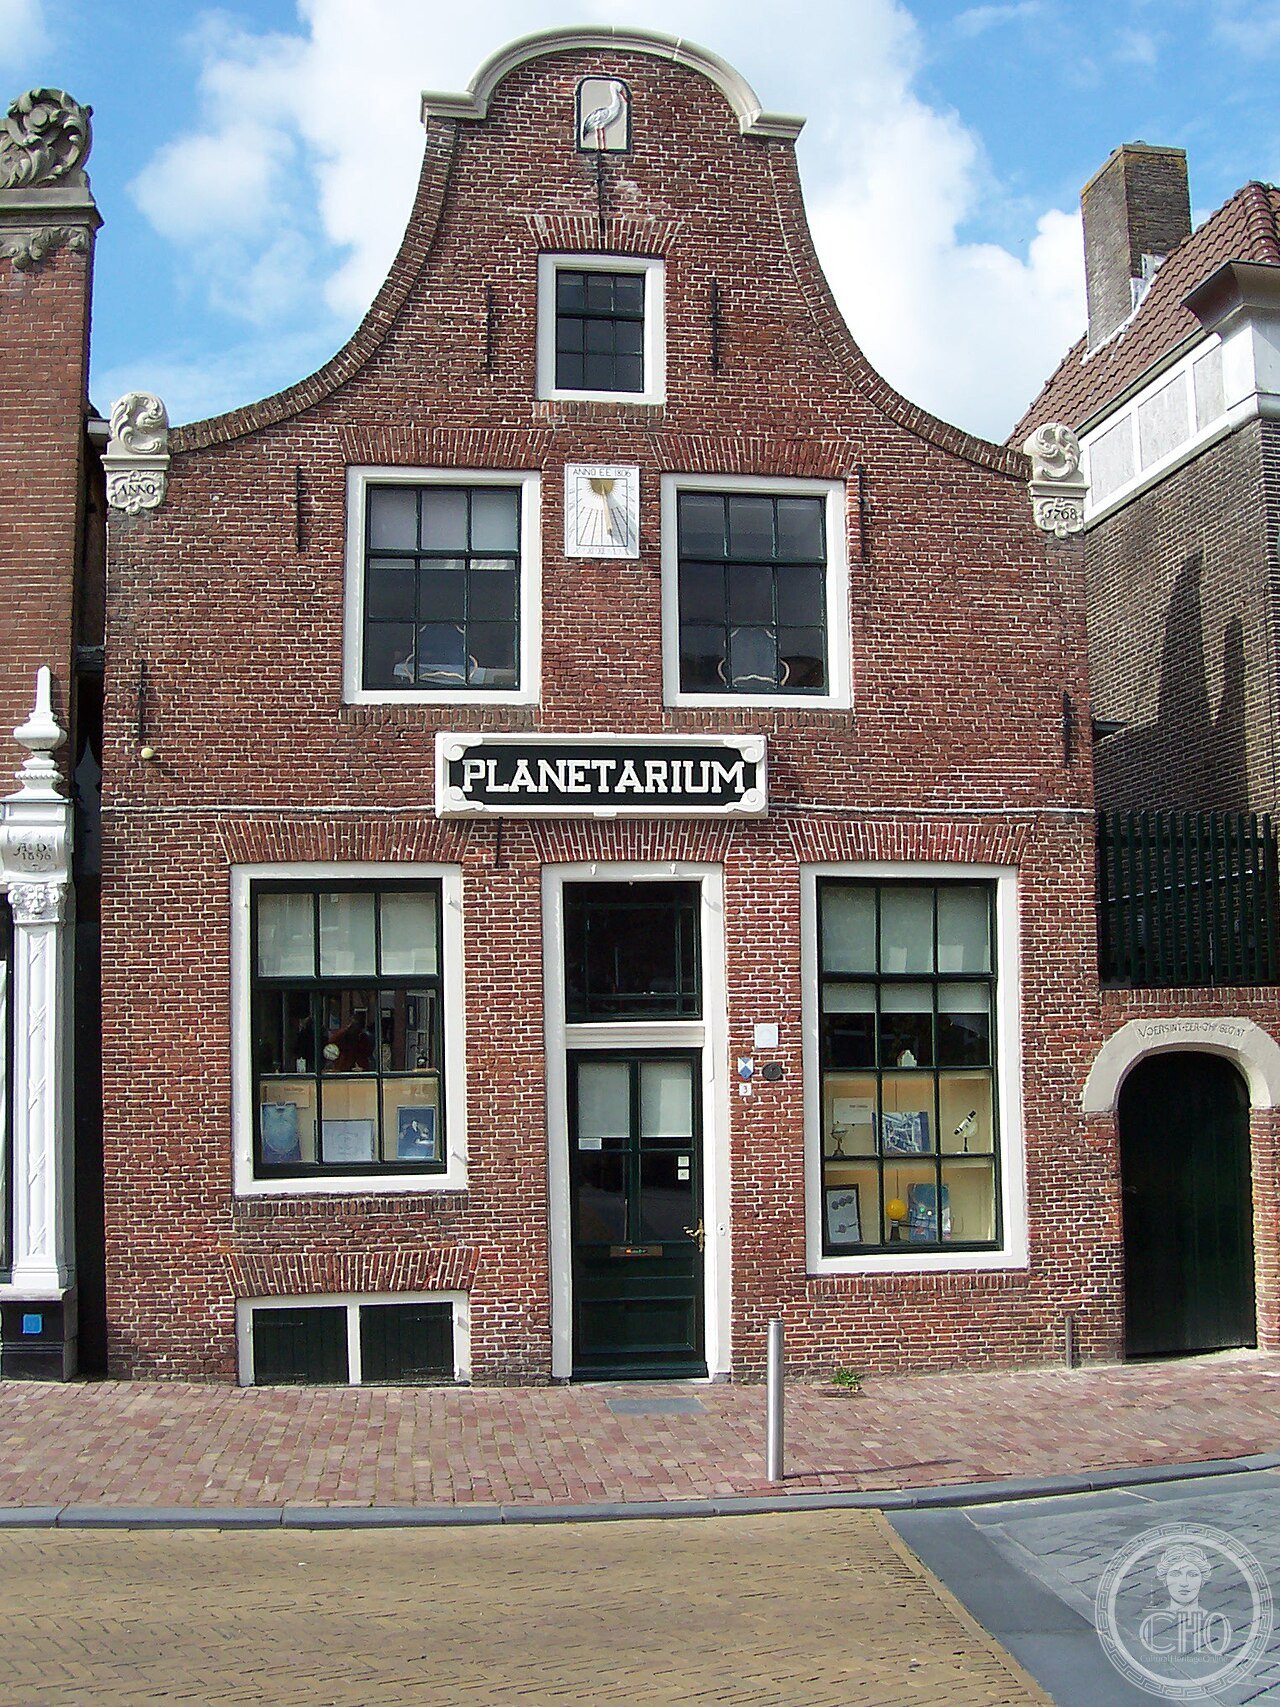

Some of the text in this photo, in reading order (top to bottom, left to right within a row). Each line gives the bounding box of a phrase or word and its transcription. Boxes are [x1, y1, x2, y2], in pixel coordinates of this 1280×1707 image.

[573, 468, 597, 476] ANNO
[117, 484, 156, 496] ANNO
[462, 759, 747, 794] PLANETARIUM
